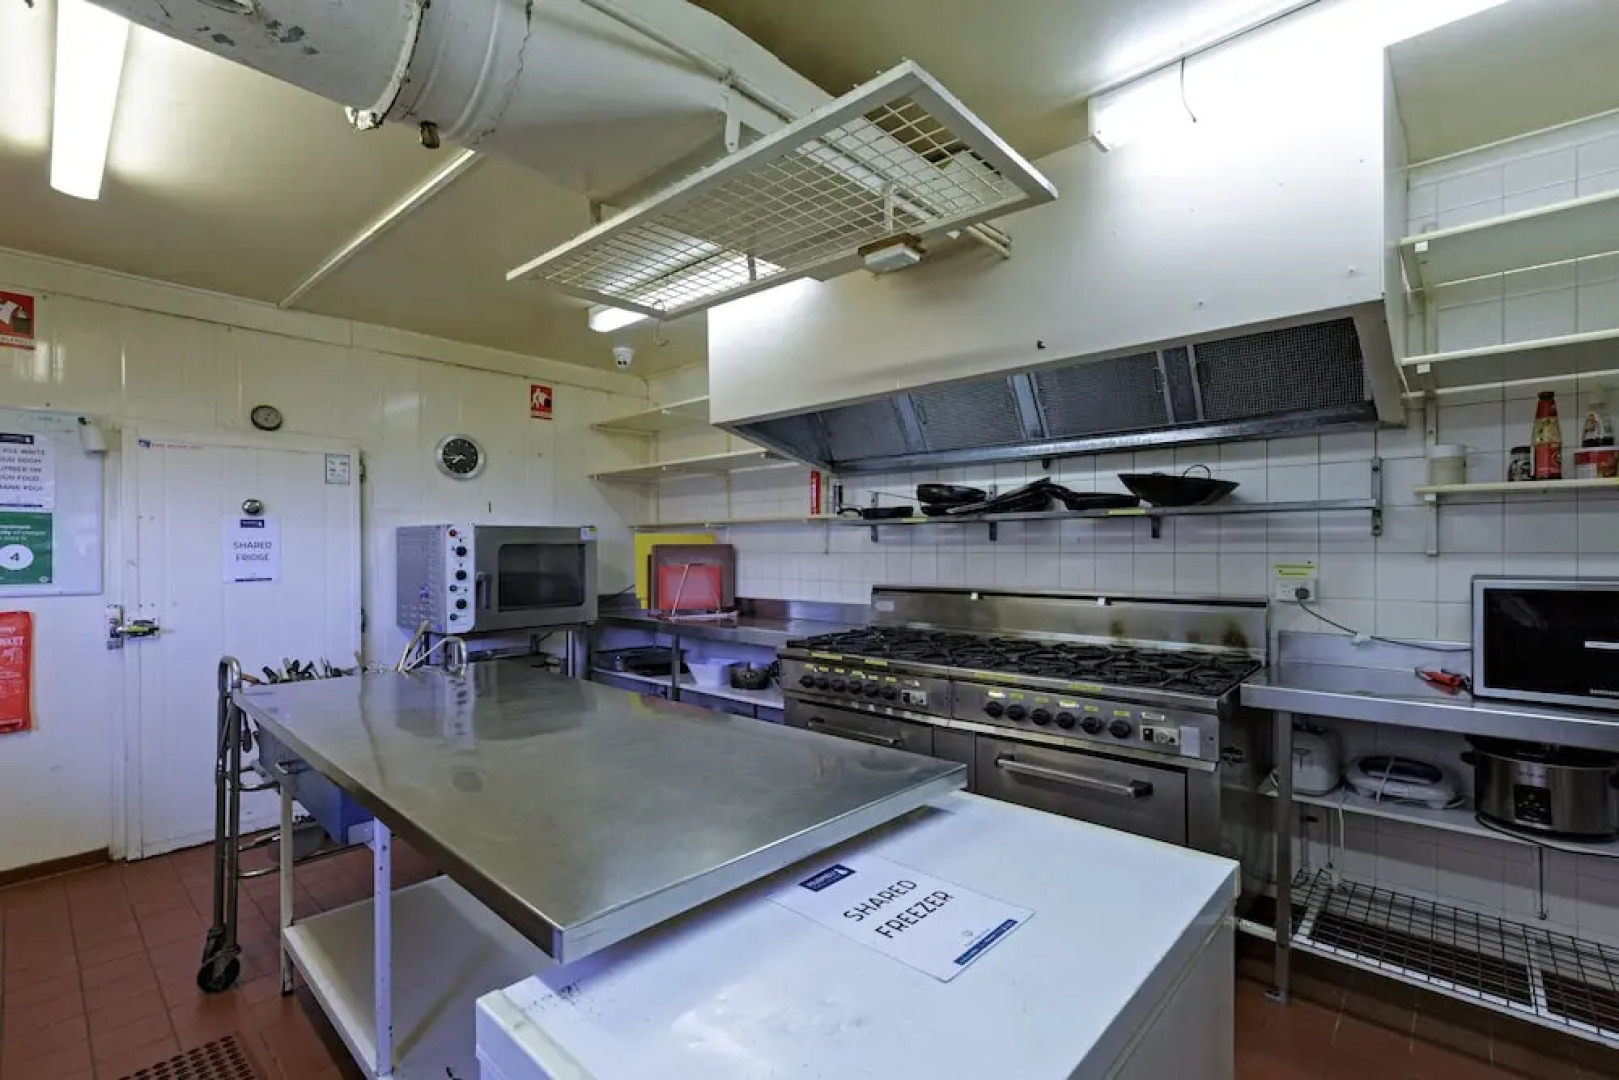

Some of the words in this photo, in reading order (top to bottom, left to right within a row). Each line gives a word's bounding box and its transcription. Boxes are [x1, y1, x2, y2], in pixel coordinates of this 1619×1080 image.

[232, 541, 273, 550] SHARED
[9, 551, 20, 562] 4
[235, 552, 270, 562] FRIDGE
[842, 878, 918, 922] SHARED
[873, 889, 955, 939] FREEZER
